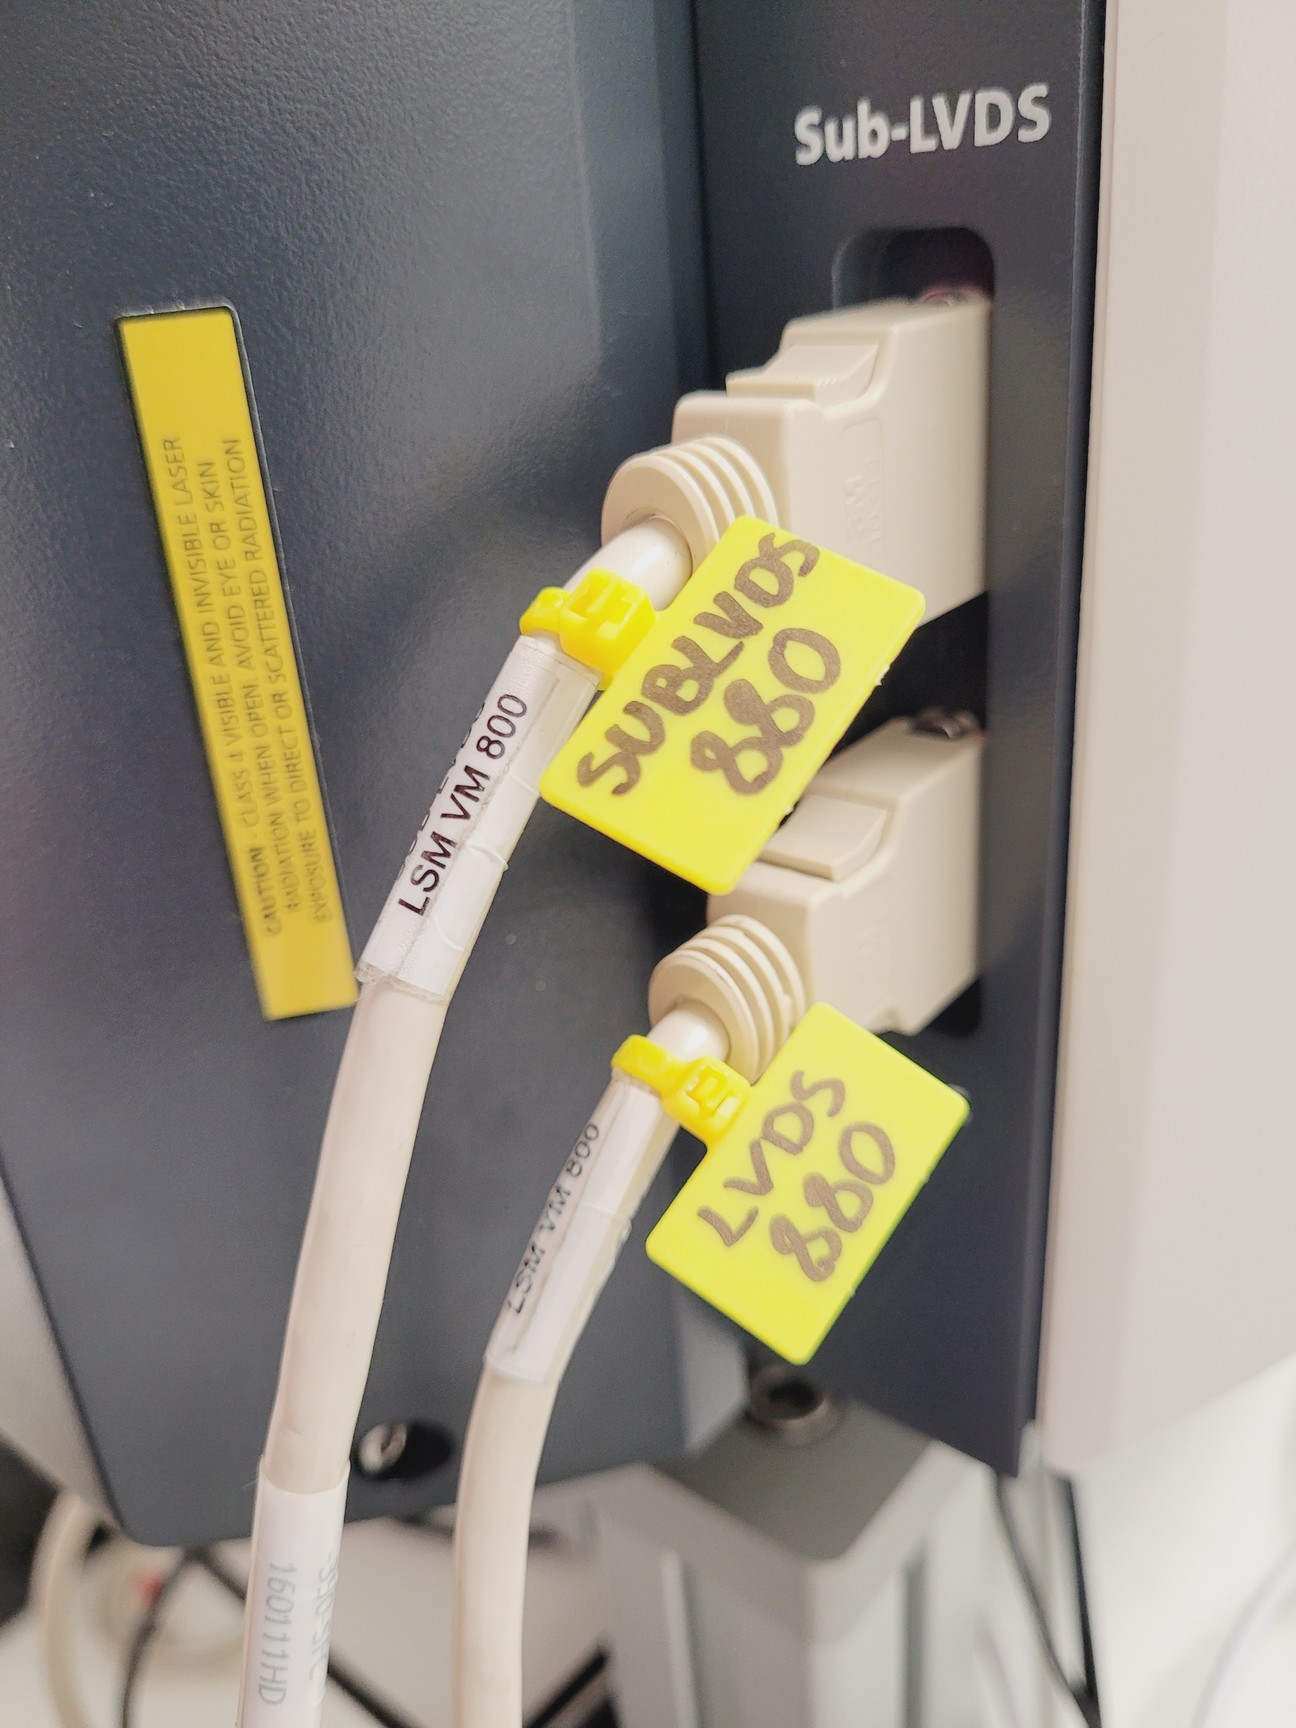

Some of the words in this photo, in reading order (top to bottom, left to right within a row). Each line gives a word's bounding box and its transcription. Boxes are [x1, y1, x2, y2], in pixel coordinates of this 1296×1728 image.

[795, 82, 1050, 166] Sub-LVDS
[163, 437, 194, 506] LASER
[198, 461, 226, 514] SKIN
[222, 438, 264, 562] RADIATION
[178, 513, 216, 614] INVISIBLE
[210, 521, 232, 551] OR
[216, 558, 241, 597] EYE
[202, 621, 223, 667] AND
[228, 604, 256, 670] AVOID
[250, 568, 286, 685] SCATTERED
[212, 673, 241, 745] VISIBLE
[272, 692, 294, 720] OR
[690, 627, 841, 795] 880
[233, 770, 260, 829] CLASS
[255, 745, 282, 801] WHEN
[279, 726, 308, 794] DIRECT
[294, 801, 313, 823] TO
[398, 831, 458, 916] LSM
[440, 764, 491, 821] VM
[476, 693, 527, 760] 800
[249, 847, 283, 936] CAUTION
[267, 812, 302, 914] RADIATION
[299, 828, 334, 926] EXPOSURE
[697, 1070, 846, 1247] LVDS
[508, 1243, 545, 1314] LSM
[539, 1185, 571, 1231] VM
[565, 1122, 600, 1177] 800
[769, 1121, 896, 1283] 880
[258, 1562, 297, 1706] 160111HD
